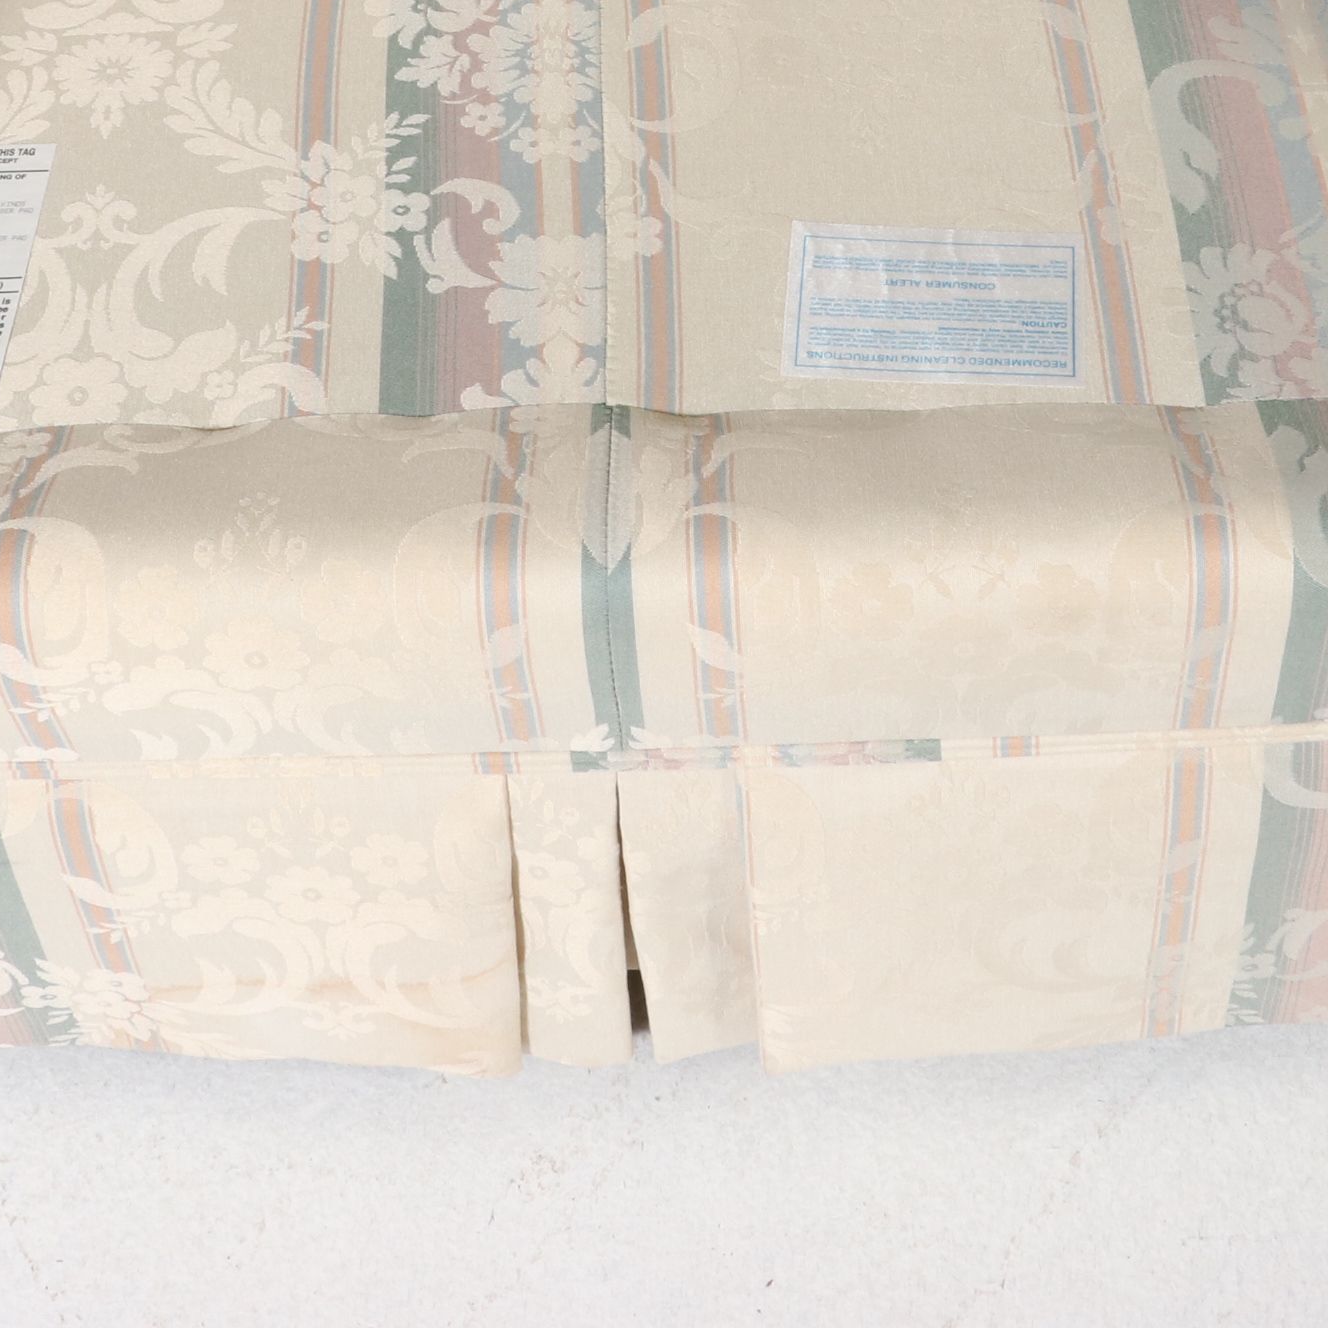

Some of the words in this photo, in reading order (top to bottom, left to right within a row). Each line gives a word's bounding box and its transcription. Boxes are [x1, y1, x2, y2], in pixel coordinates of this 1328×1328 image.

[18, 148, 35, 156] TAG
[881, 278, 921, 287] ALERT
[926, 280, 996, 290] CONSUMER
[806, 351, 898, 363] INSTRUCTIONS
[902, 356, 966, 365] CLEANING
[968, 357, 1067, 368] RECOMMENDED
